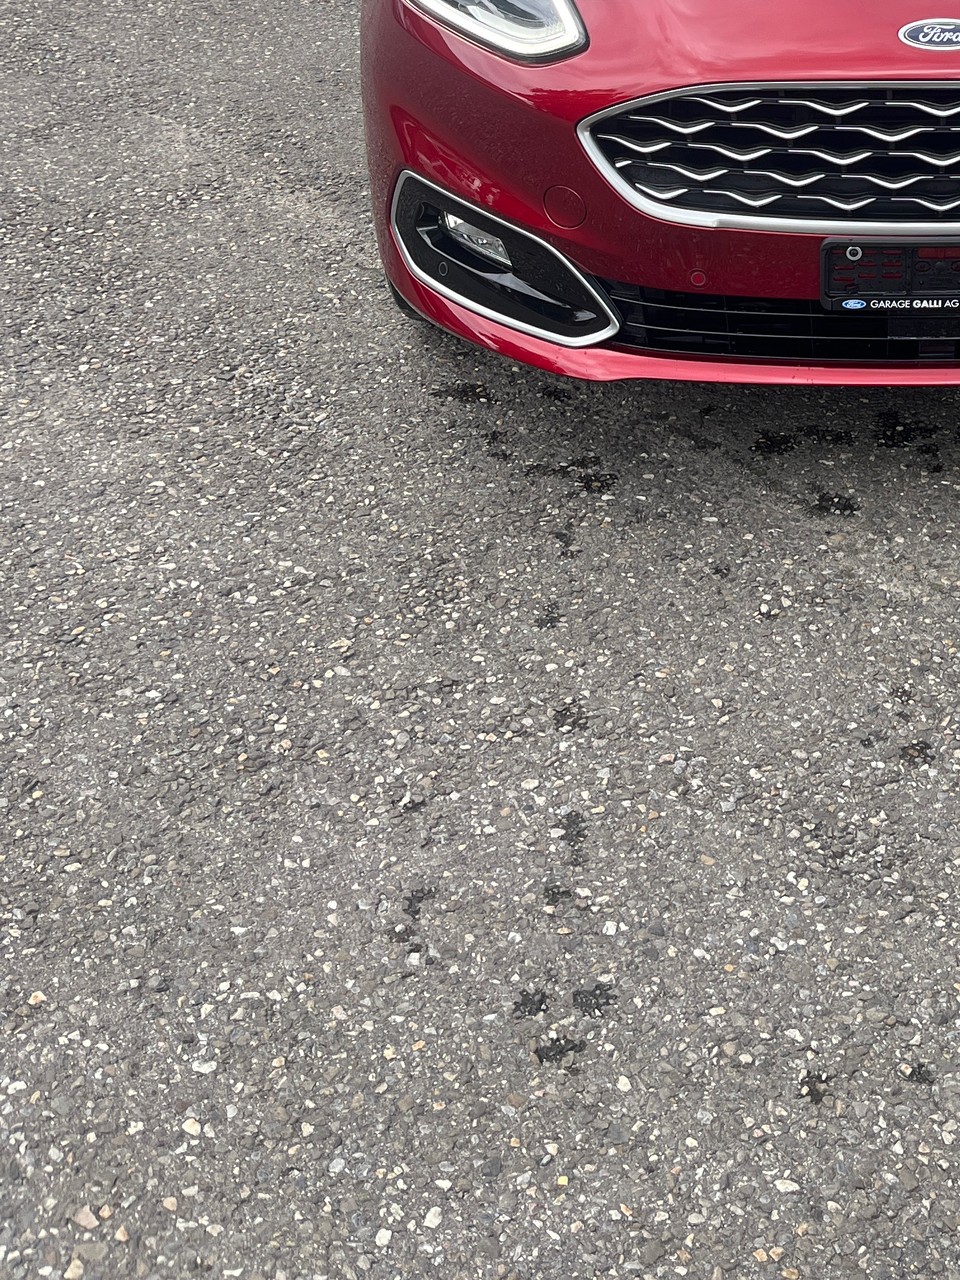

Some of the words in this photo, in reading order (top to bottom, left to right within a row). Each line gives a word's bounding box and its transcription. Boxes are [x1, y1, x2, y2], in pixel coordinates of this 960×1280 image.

[870, 299, 911, 309] GARAGE
[912, 299, 942, 309] GALLI
[943, 299, 960, 308] AG
